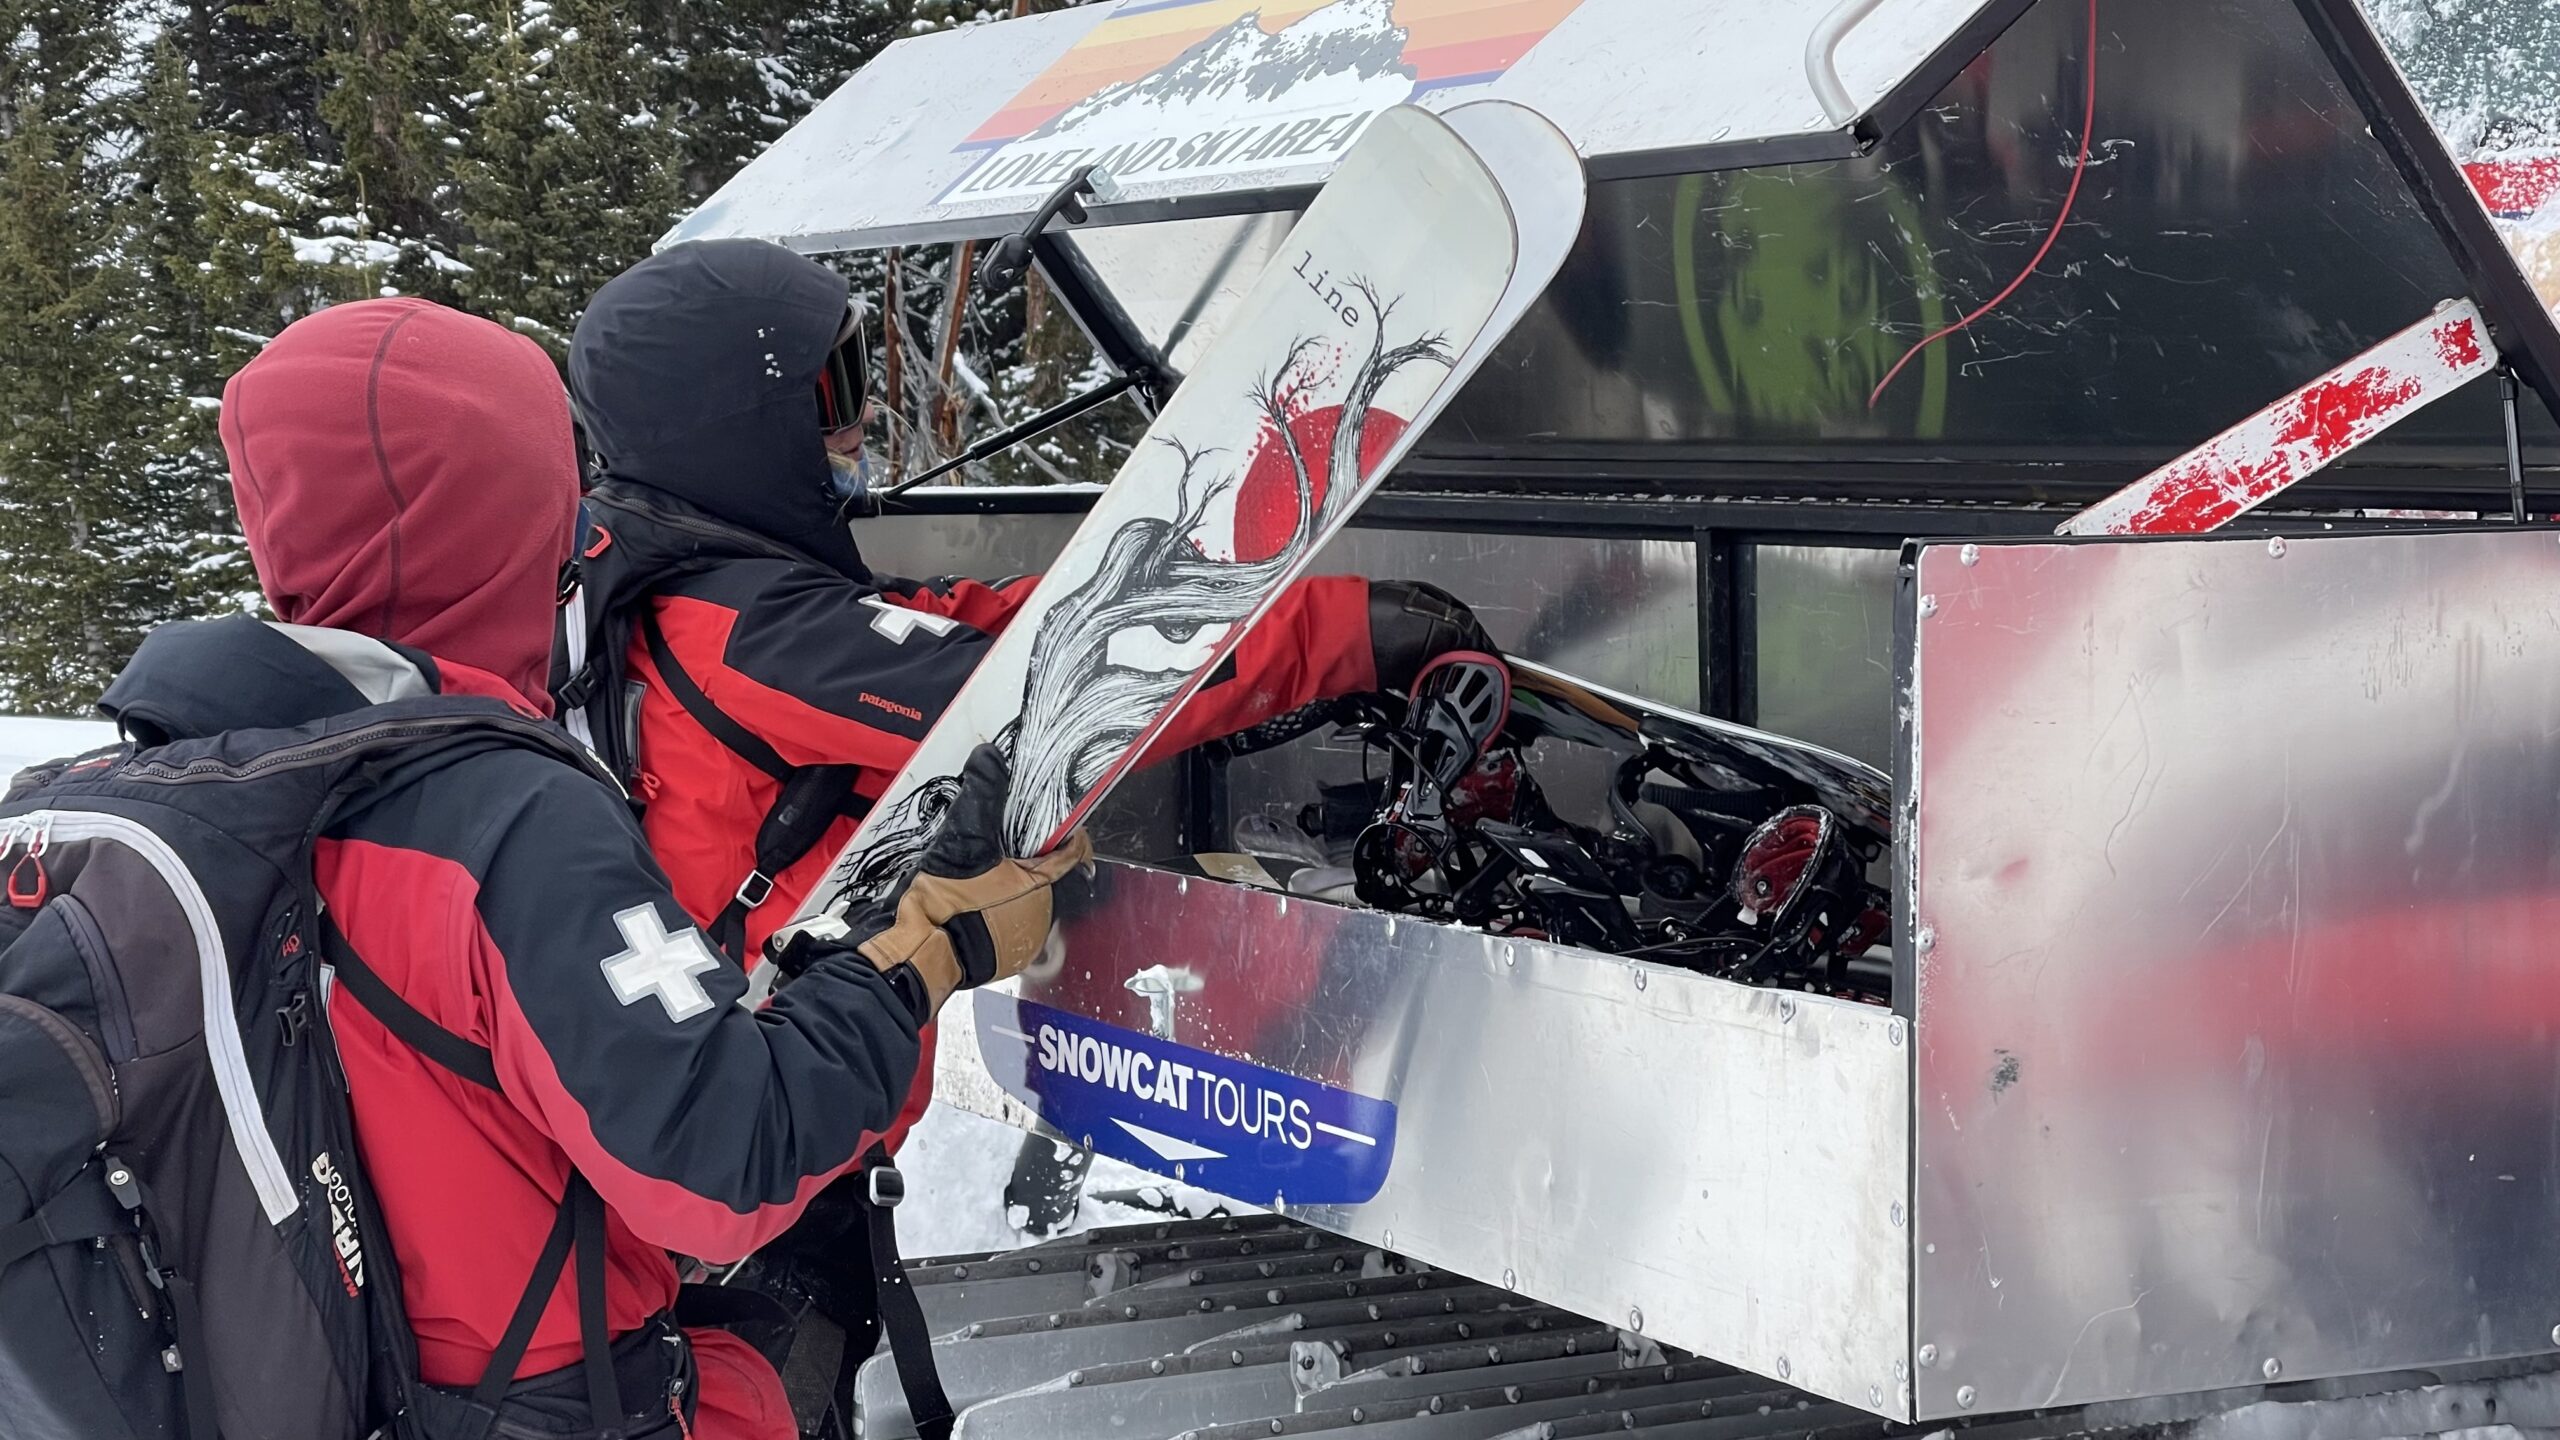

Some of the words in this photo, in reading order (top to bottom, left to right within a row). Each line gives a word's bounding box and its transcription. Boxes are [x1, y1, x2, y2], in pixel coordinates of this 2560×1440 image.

[960, 137, 1177, 193] LOVELAND
[1157, 126, 1261, 172] SKI
[1227, 110, 1374, 163] AREA
[1293, 250, 1358, 327] line
[859, 692, 922, 721] patagonia
[1038, 1024, 1193, 1111] SNOWCAT
[1197, 1070, 1312, 1149] TOURS
